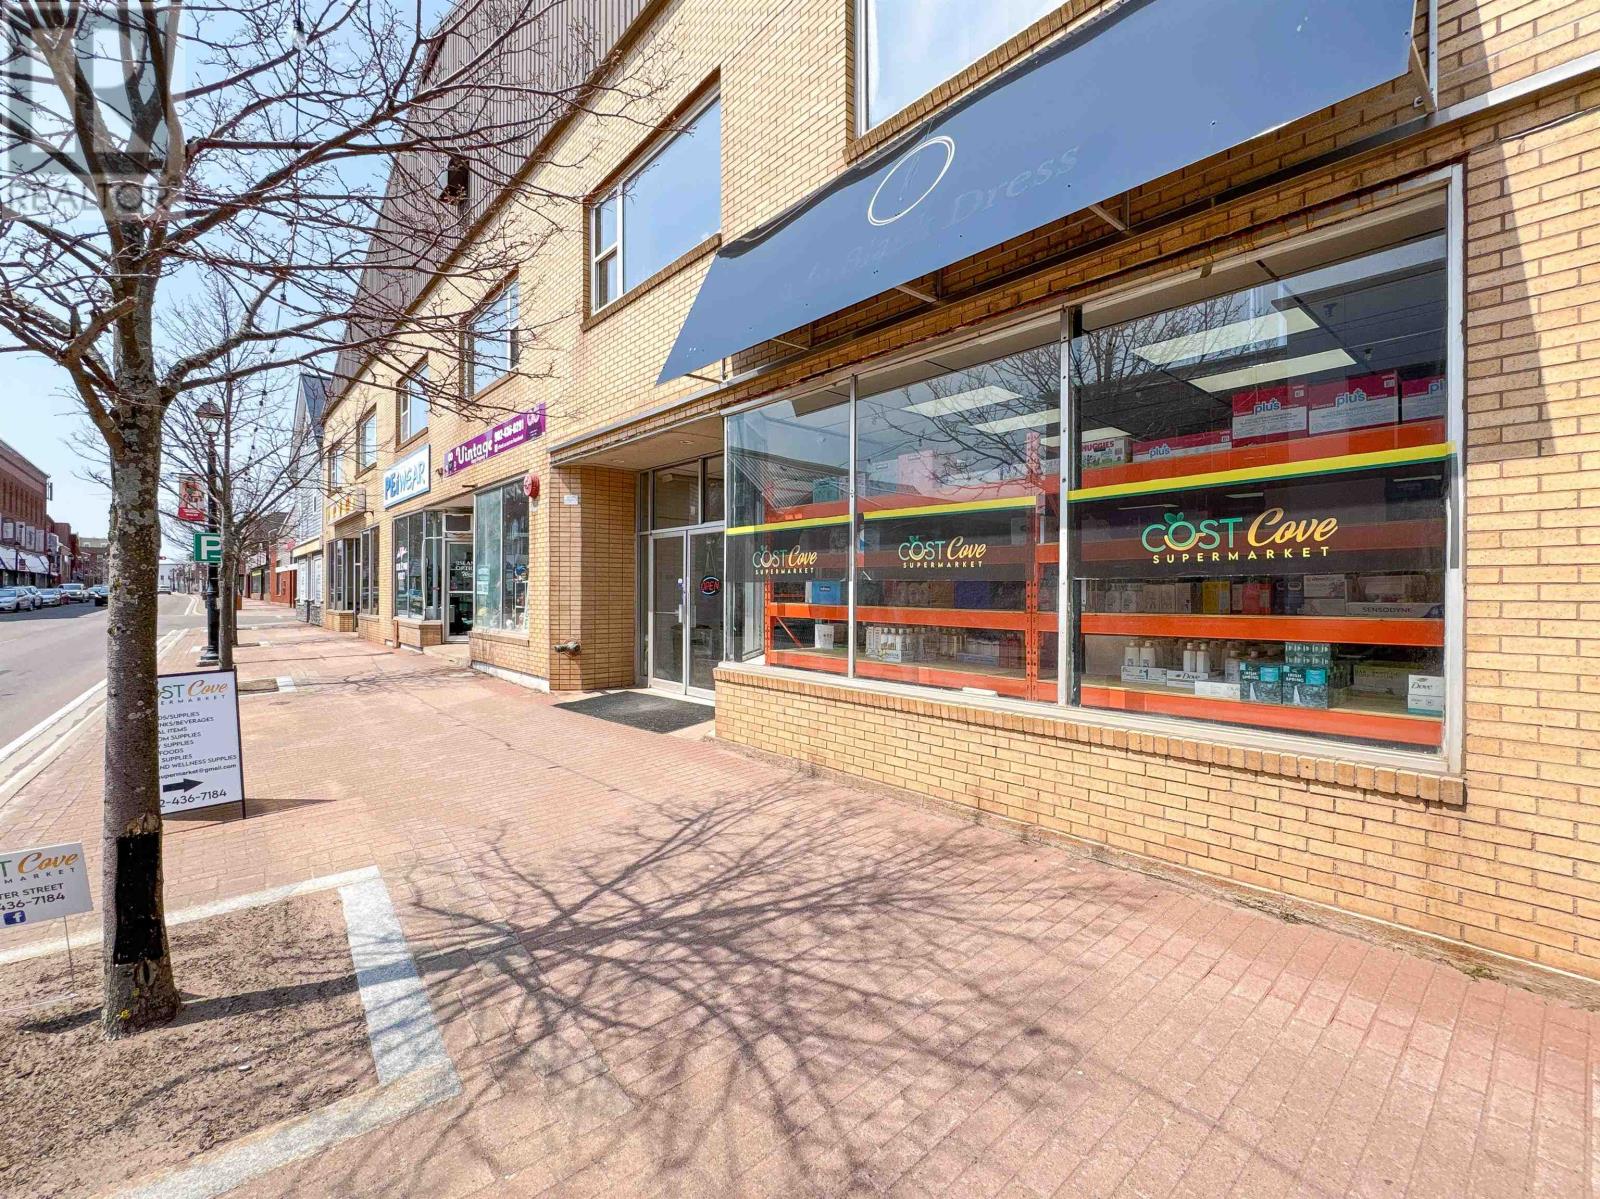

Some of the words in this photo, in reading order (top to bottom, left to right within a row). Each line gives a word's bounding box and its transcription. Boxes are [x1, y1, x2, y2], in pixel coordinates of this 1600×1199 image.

[1337, 391, 1365, 407] plus
[1255, 400, 1281, 415] plus
[456, 440, 493, 464] Vintage
[1149, 444, 1171, 458] plus
[1141, 516, 1243, 552] COST
[1247, 507, 1338, 548] Cove
[201, 535, 222, 559] P
[898, 540, 945, 561] COST
[947, 535, 987, 560] Cove
[1152, 546, 1330, 564] SUPERMARKET
[752, 549, 787, 568] COST
[788, 544, 818, 567] Cove
[755, 567, 814, 575] SUPERMARKET
[903, 561, 983, 569] SUPERMARKET
[701, 581, 721, 592] OPEN
[159, 684, 185, 699] ST
[188, 679, 228, 696] Cove
[1411, 681, 1433, 690] Dove
[160, 694, 225, 705] ERMARKET
[158, 711, 200, 720] DS/SUPPLIES
[159, 717, 215, 727] NKS/BEVERAGES
[163, 739, 194, 748] SUPPLIES
[171, 731, 202, 740] SUPPLIES
[161, 754, 193, 762] SUPPLIES
[171, 758, 206, 768] WELLNESS
[207, 755, 237, 763] SUPPLIES
[160, 763, 237, 779] upermarket@gmail.com
[160, 789, 227, 808] 2-436-7184
[18, 852, 79, 874] Cove
[4, 867, 75, 884] MARKET
[0, 891, 19, 900] TER
[22, 882, 64, 896] STREET
[0, 892, 66, 911] 436-7184
